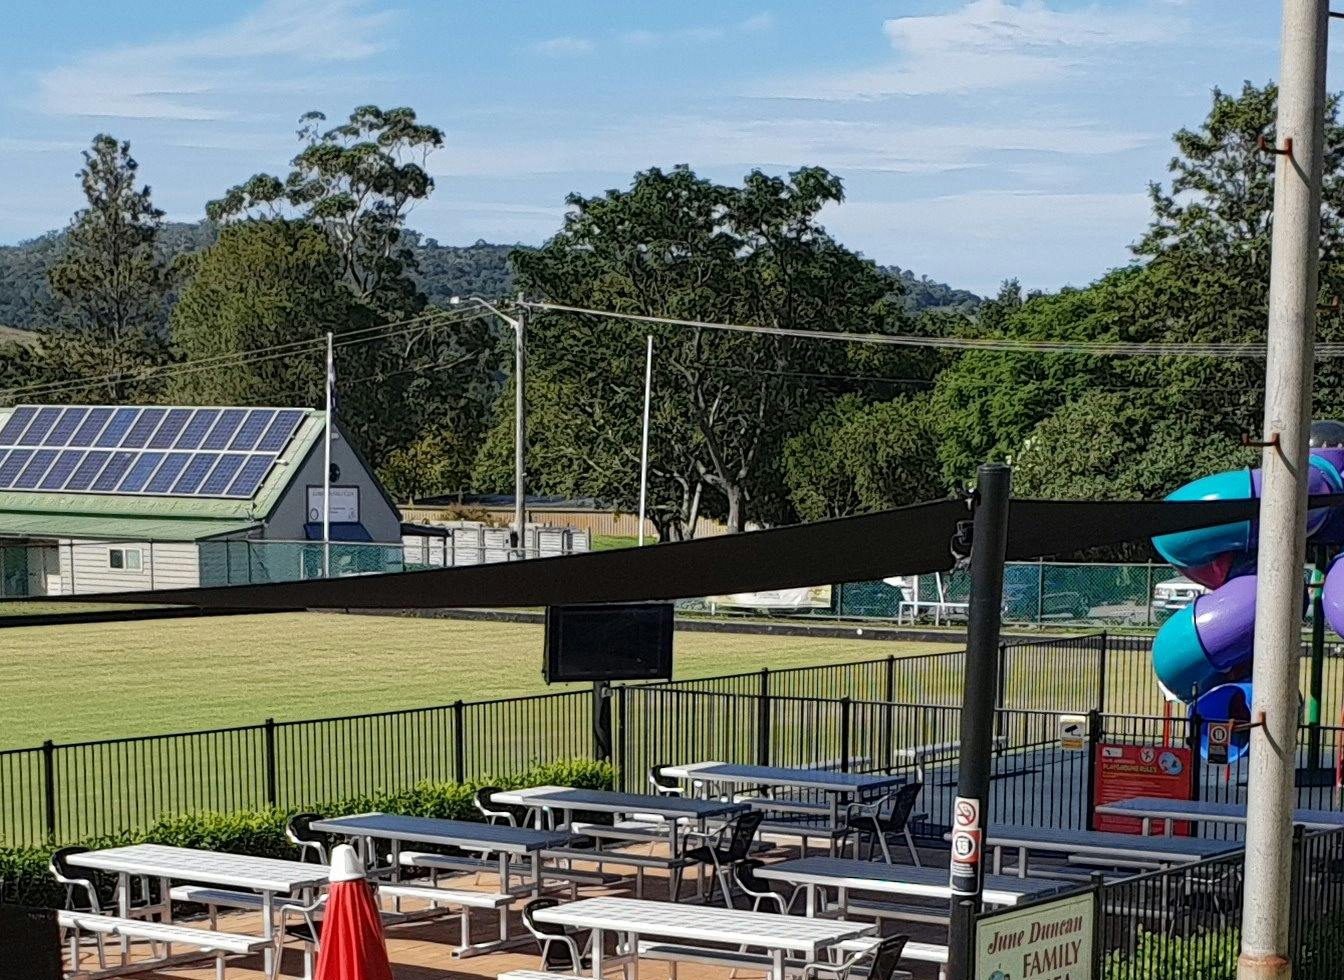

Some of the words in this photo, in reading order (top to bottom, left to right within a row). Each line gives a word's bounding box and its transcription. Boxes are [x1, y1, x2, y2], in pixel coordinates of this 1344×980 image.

[987, 930, 1024, 955] June
[1028, 915, 1084, 945] Duncan
[1022, 939, 1083, 979] FAMILY
